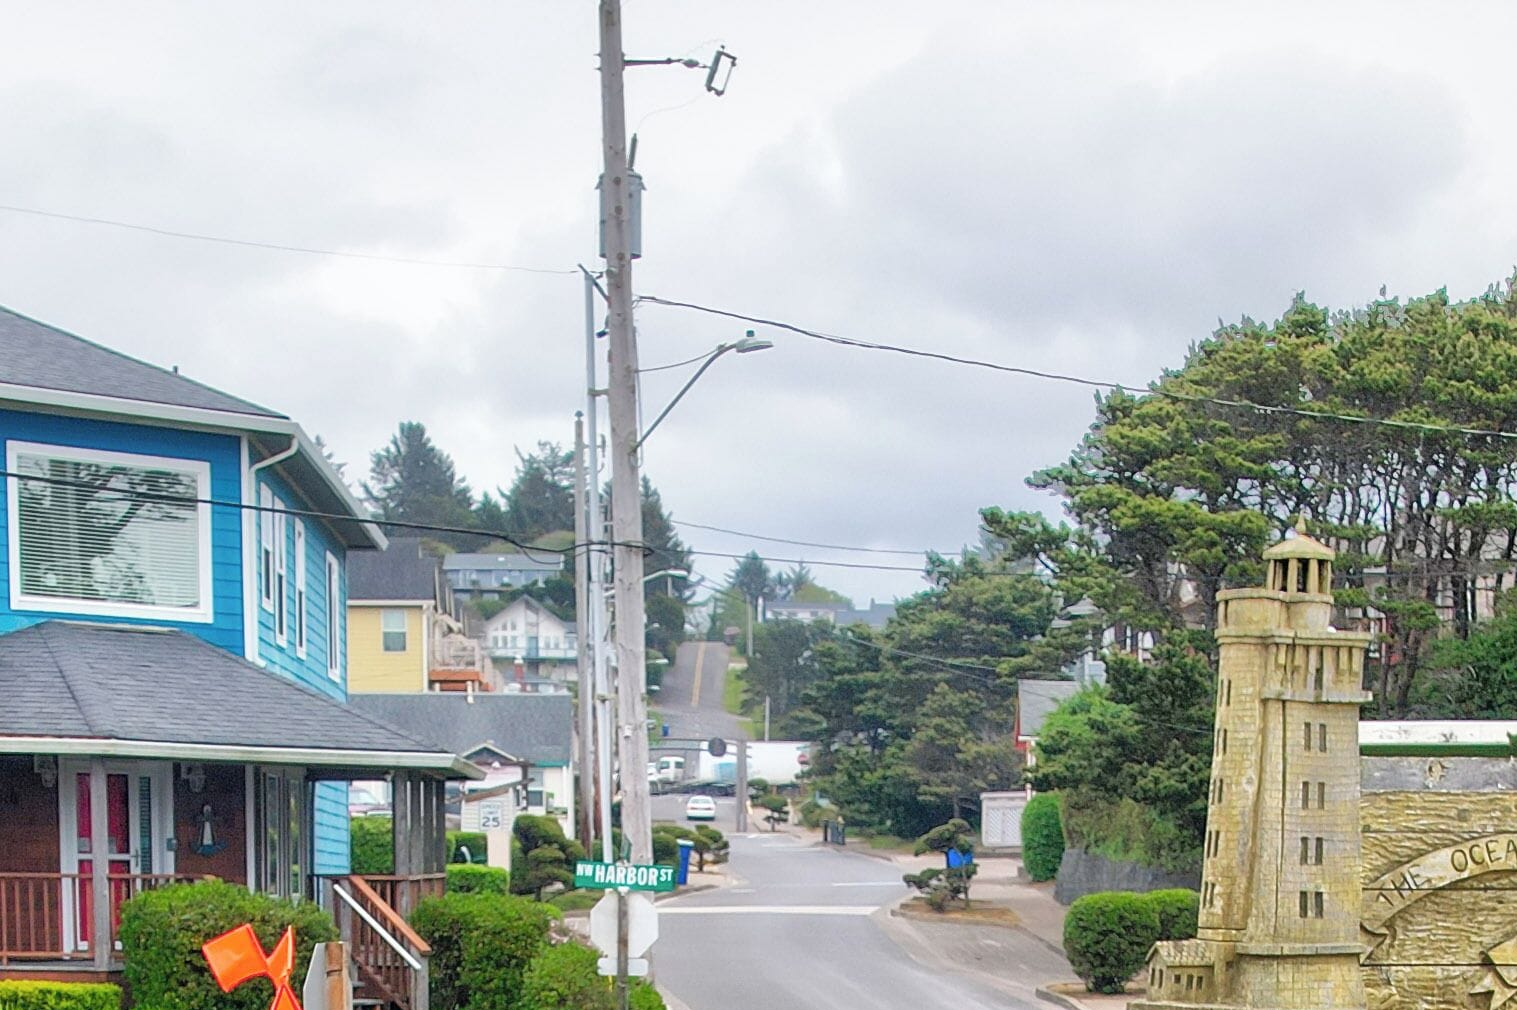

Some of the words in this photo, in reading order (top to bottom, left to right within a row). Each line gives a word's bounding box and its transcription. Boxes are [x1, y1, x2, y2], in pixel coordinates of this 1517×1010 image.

[481, 816, 501, 829] 25
[576, 863, 594, 877] NW
[595, 864, 659, 886] HARBOR
[659, 868, 674, 882] ST
[1376, 864, 1428, 906] THE
